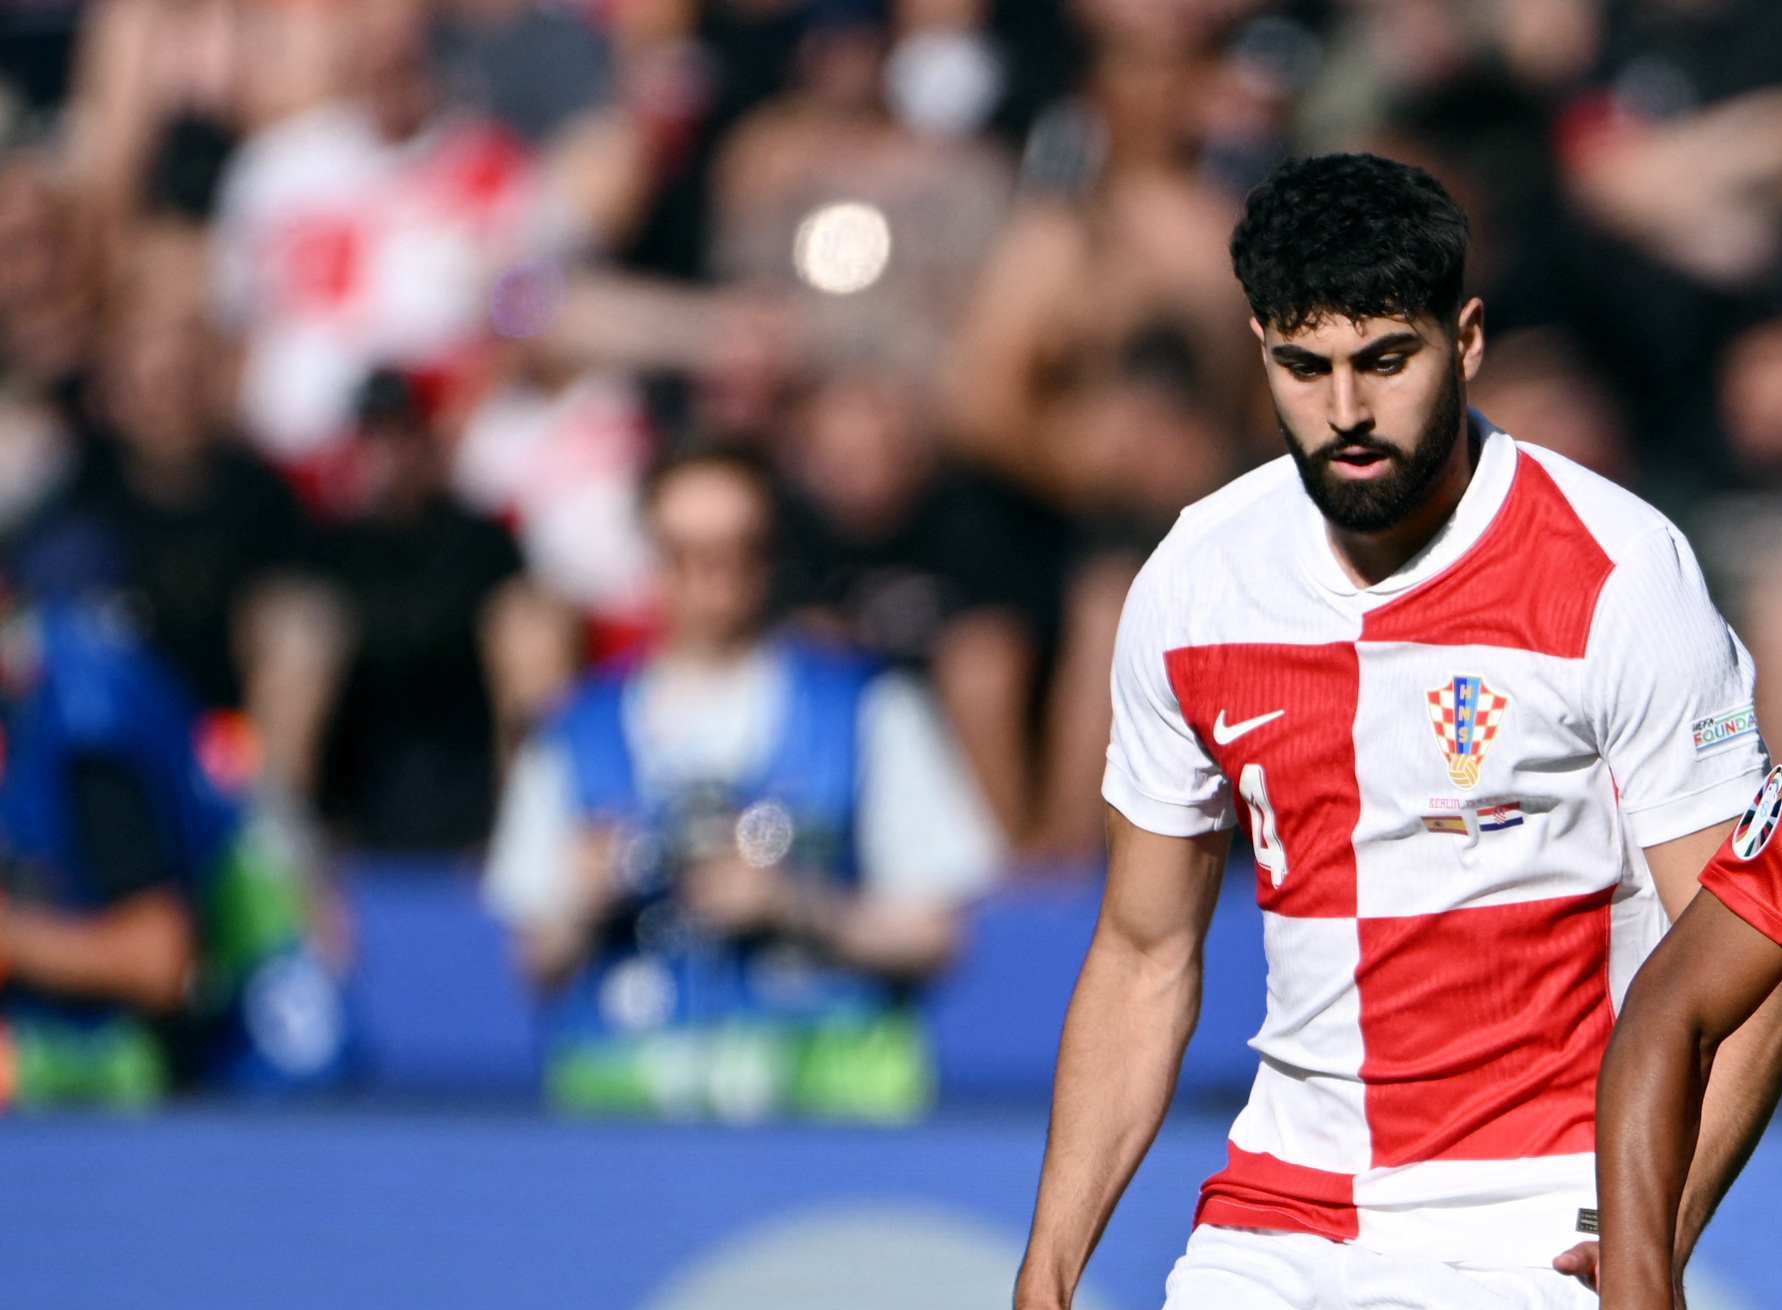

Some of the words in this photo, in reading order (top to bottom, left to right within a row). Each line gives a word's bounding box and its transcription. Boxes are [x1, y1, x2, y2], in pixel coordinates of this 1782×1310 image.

[1457, 684, 1472, 743] HNS
[1692, 717, 1714, 732] UEFA
[1239, 764, 1288, 889] 4
